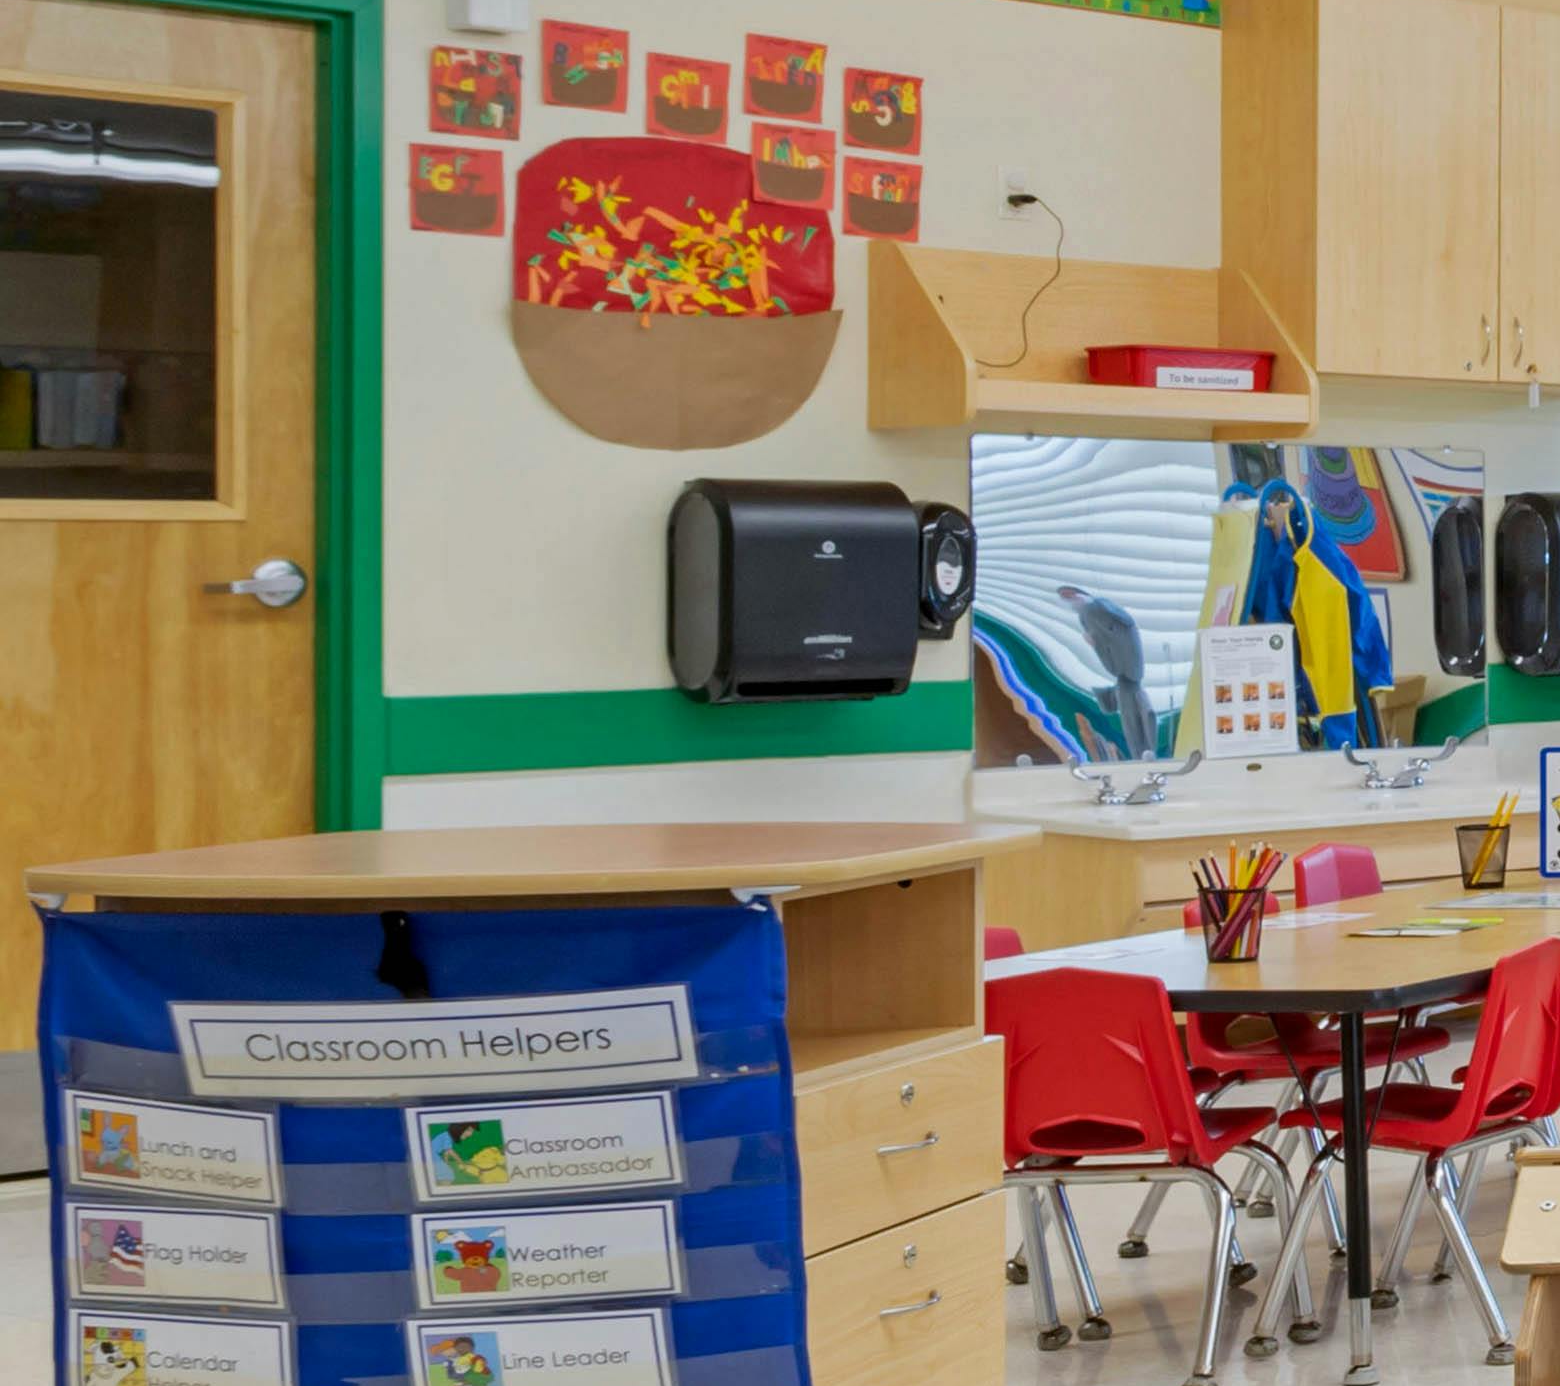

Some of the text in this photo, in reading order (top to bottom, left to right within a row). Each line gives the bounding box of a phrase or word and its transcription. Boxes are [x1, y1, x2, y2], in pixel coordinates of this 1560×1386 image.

[245, 1027, 612, 1063] Classroom Helpers
[140, 1136, 237, 1163] Lunch and
[503, 1133, 625, 1157] Classroom
[140, 1162, 262, 1190] Snack Helper
[509, 1154, 654, 1180] Ambassador
[144, 1243, 249, 1265] Flag Holder
[508, 1242, 607, 1263] Weather
[511, 1267, 609, 1292] Reporter
[146, 1350, 239, 1374] Calendar
[502, 1347, 630, 1371] Line Leader
